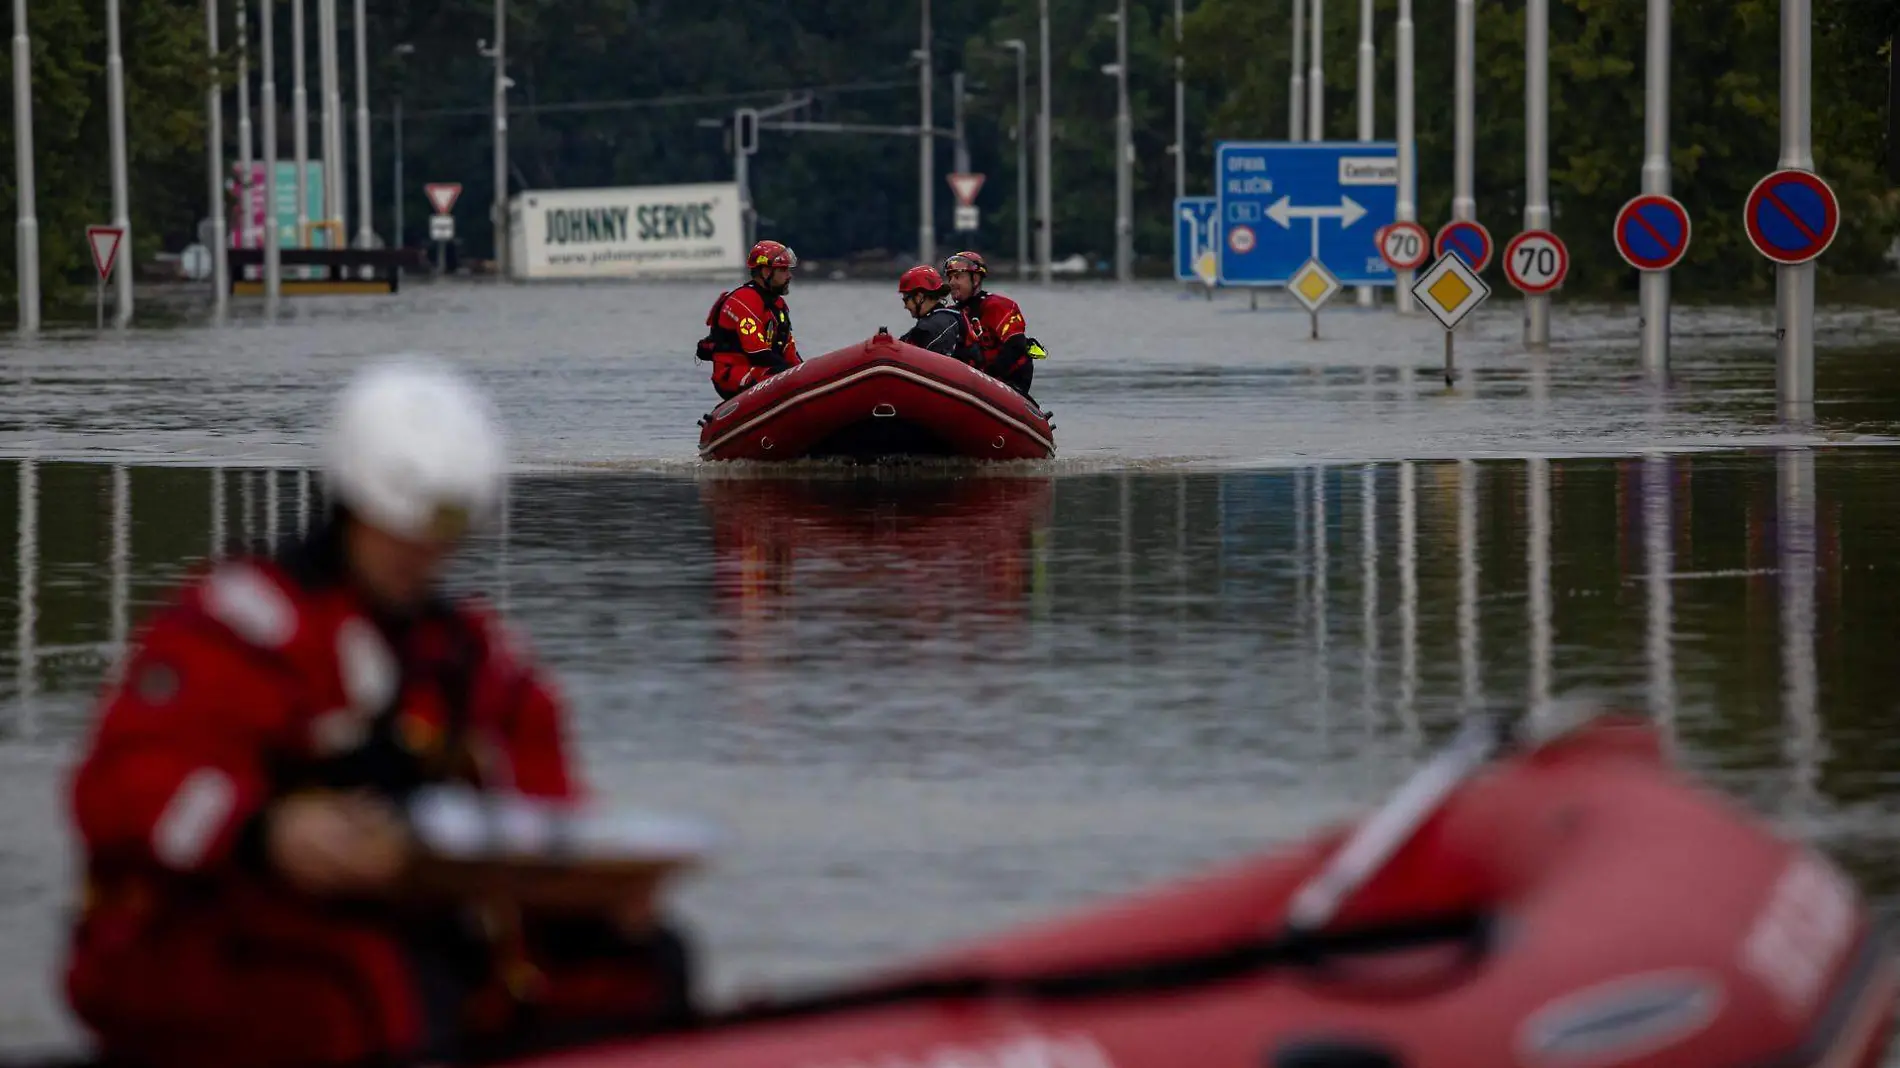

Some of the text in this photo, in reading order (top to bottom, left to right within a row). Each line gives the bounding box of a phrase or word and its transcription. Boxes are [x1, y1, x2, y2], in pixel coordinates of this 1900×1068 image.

[545, 201, 715, 245] JOHNNY SERVIS
[1391, 234, 1418, 258] 70
[1519, 247, 1554, 276] 70
